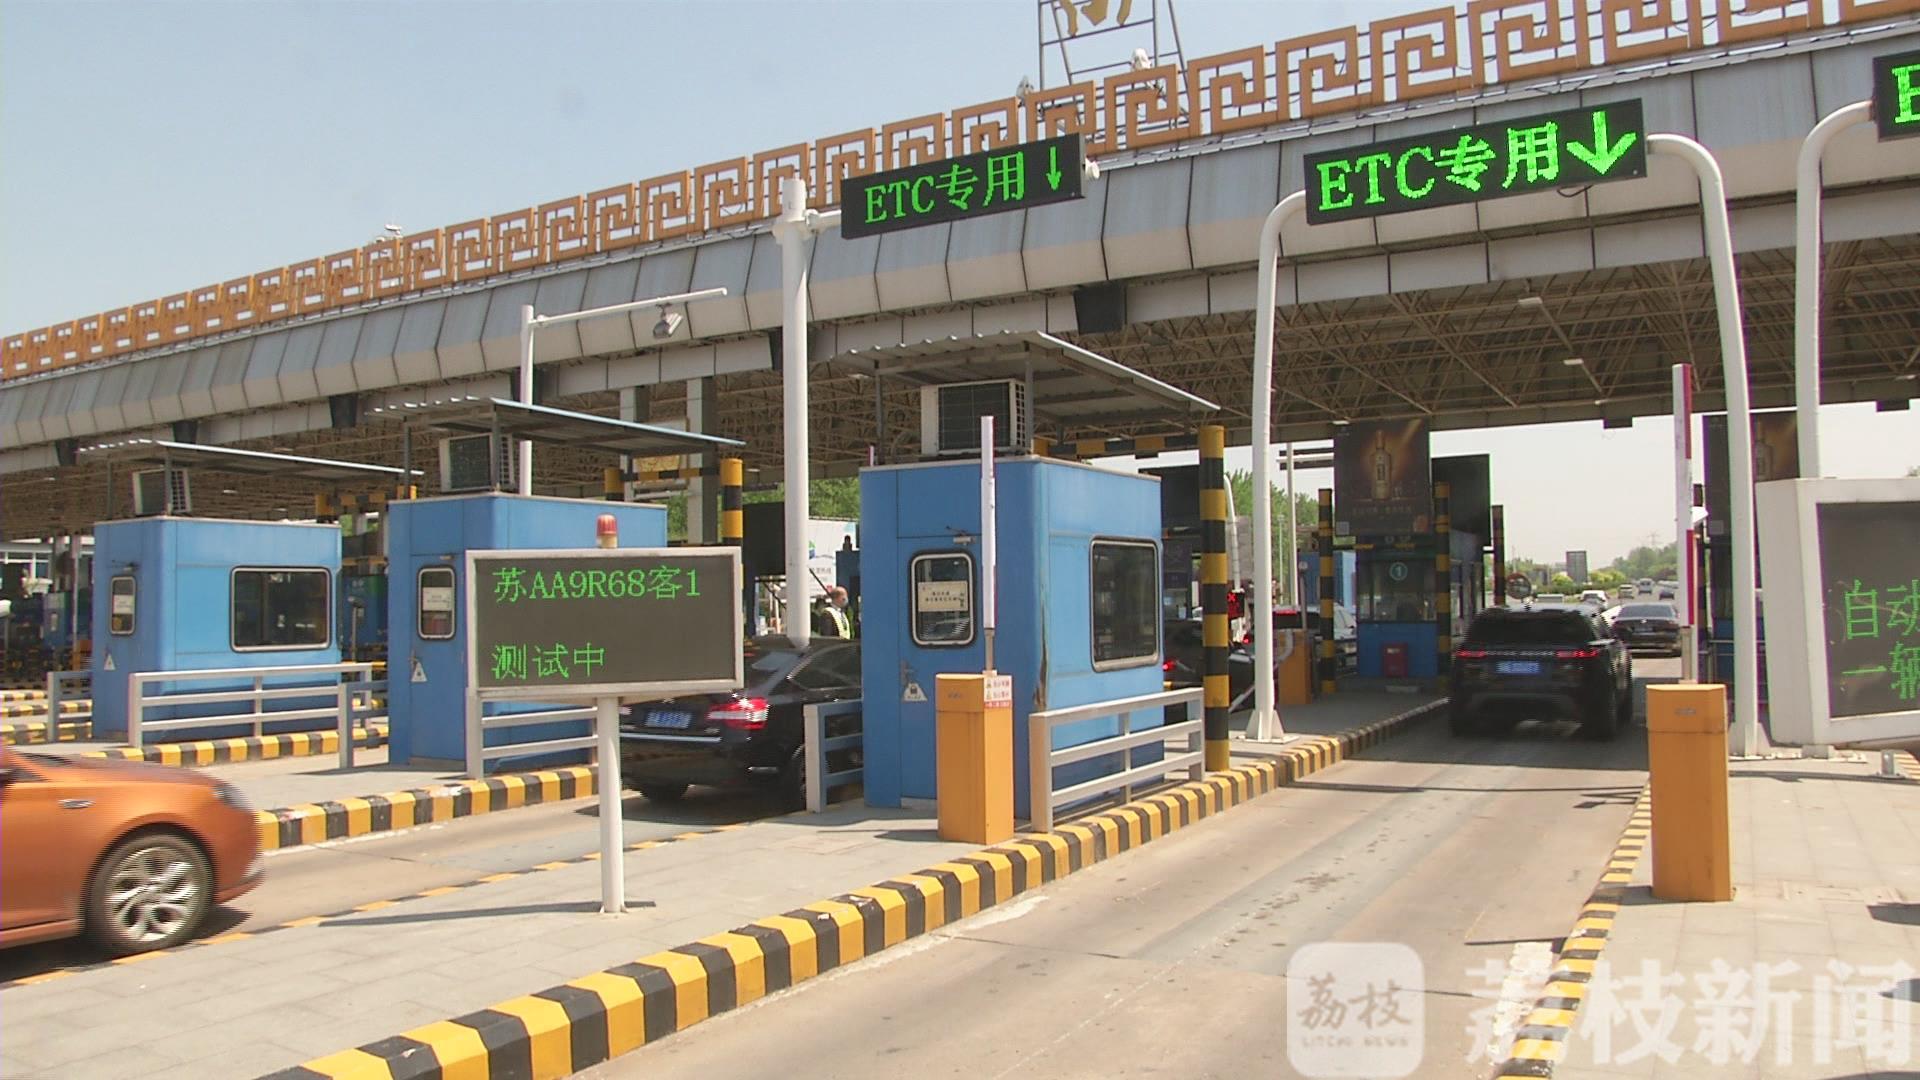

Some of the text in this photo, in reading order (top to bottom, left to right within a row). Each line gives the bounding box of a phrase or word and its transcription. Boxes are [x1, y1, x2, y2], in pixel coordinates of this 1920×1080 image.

[864, 151, 1026, 225] ETC专用
[1316, 121, 1560, 212] ETC专用
[492, 566, 701, 603] 苏AA9R68客1
[491, 643, 605, 680] 测试中
